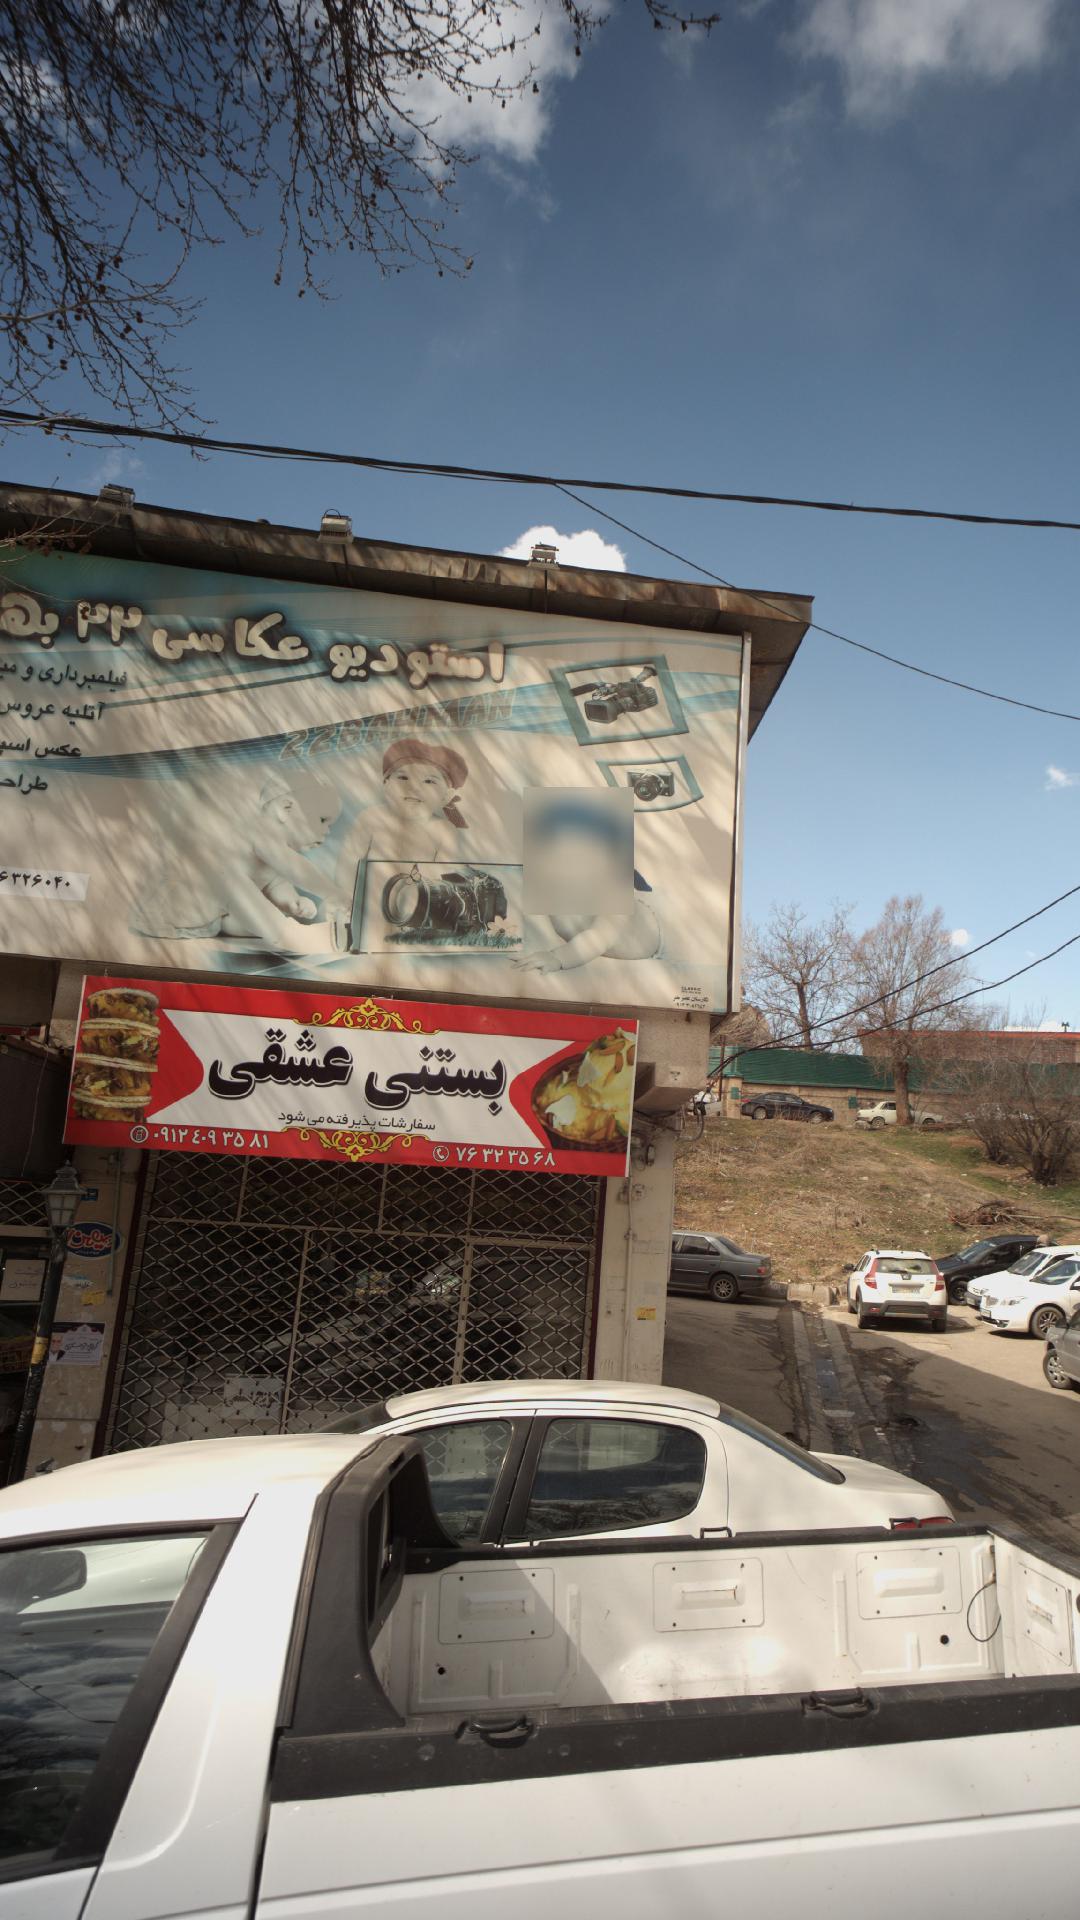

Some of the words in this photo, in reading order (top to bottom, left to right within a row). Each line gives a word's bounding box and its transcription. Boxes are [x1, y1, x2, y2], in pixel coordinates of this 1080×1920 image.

[0, 592, 60, 645] به
[151, 611, 310, 661] عکاسی
[20, 664, 34, 681] و
[38, 663, 128, 693] فیلمبرداری
[329, 640, 505, 690] استودیو
[61, 701, 106, 726] آتلیه
[34, 743, 82, 758] عکس
[0, 773, 49, 795] طراح
[207, 1026, 354, 1100] عشقی
[364, 1045, 507, 1116] بستنی
[326, 1112, 376, 1132] پذیرفته
[377, 1116, 437, 1132] سفارشات
